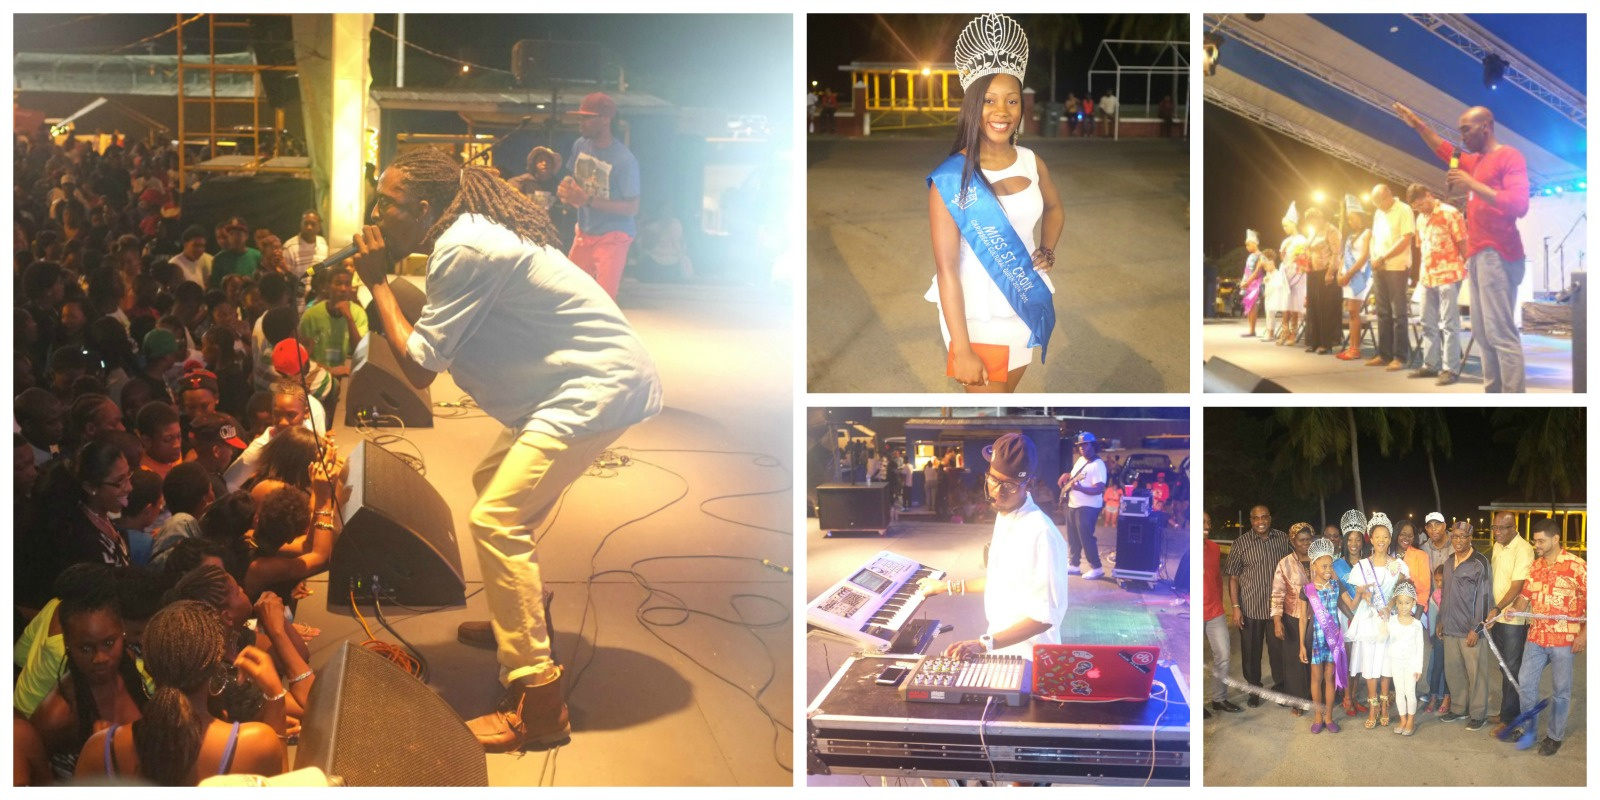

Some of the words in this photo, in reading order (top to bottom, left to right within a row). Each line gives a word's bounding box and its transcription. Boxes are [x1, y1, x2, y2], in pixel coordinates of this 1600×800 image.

[983, 226, 1008, 250] MISS
[1001, 251, 1016, 266] ST.
[1013, 267, 1034, 292] CROIX
